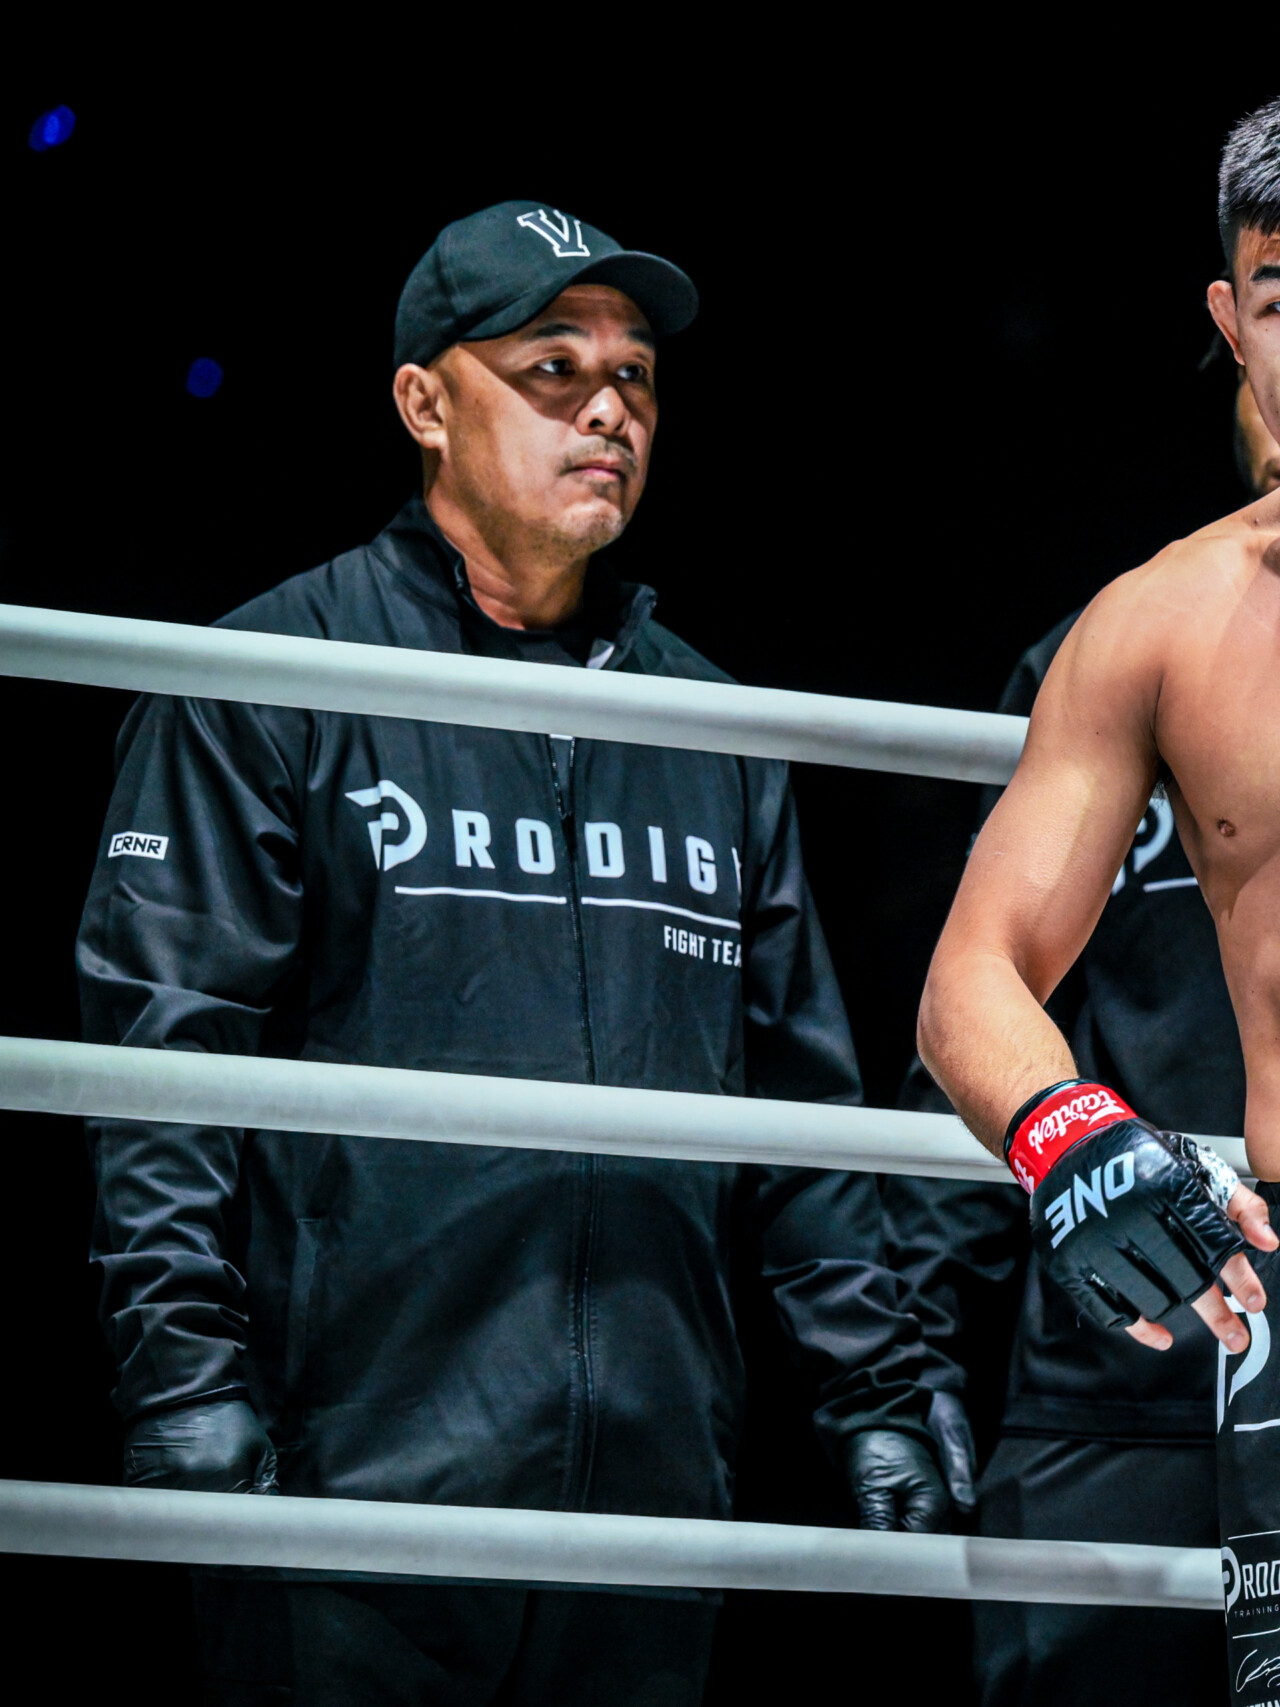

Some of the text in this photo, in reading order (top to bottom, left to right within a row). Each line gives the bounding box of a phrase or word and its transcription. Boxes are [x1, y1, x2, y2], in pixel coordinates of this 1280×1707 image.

[113, 836, 162, 855] CRNR
[344, 779, 742, 895] PRODIG
[664, 925, 742, 968] FIGHT TEA
[1044, 1151, 1136, 1249] ONE
